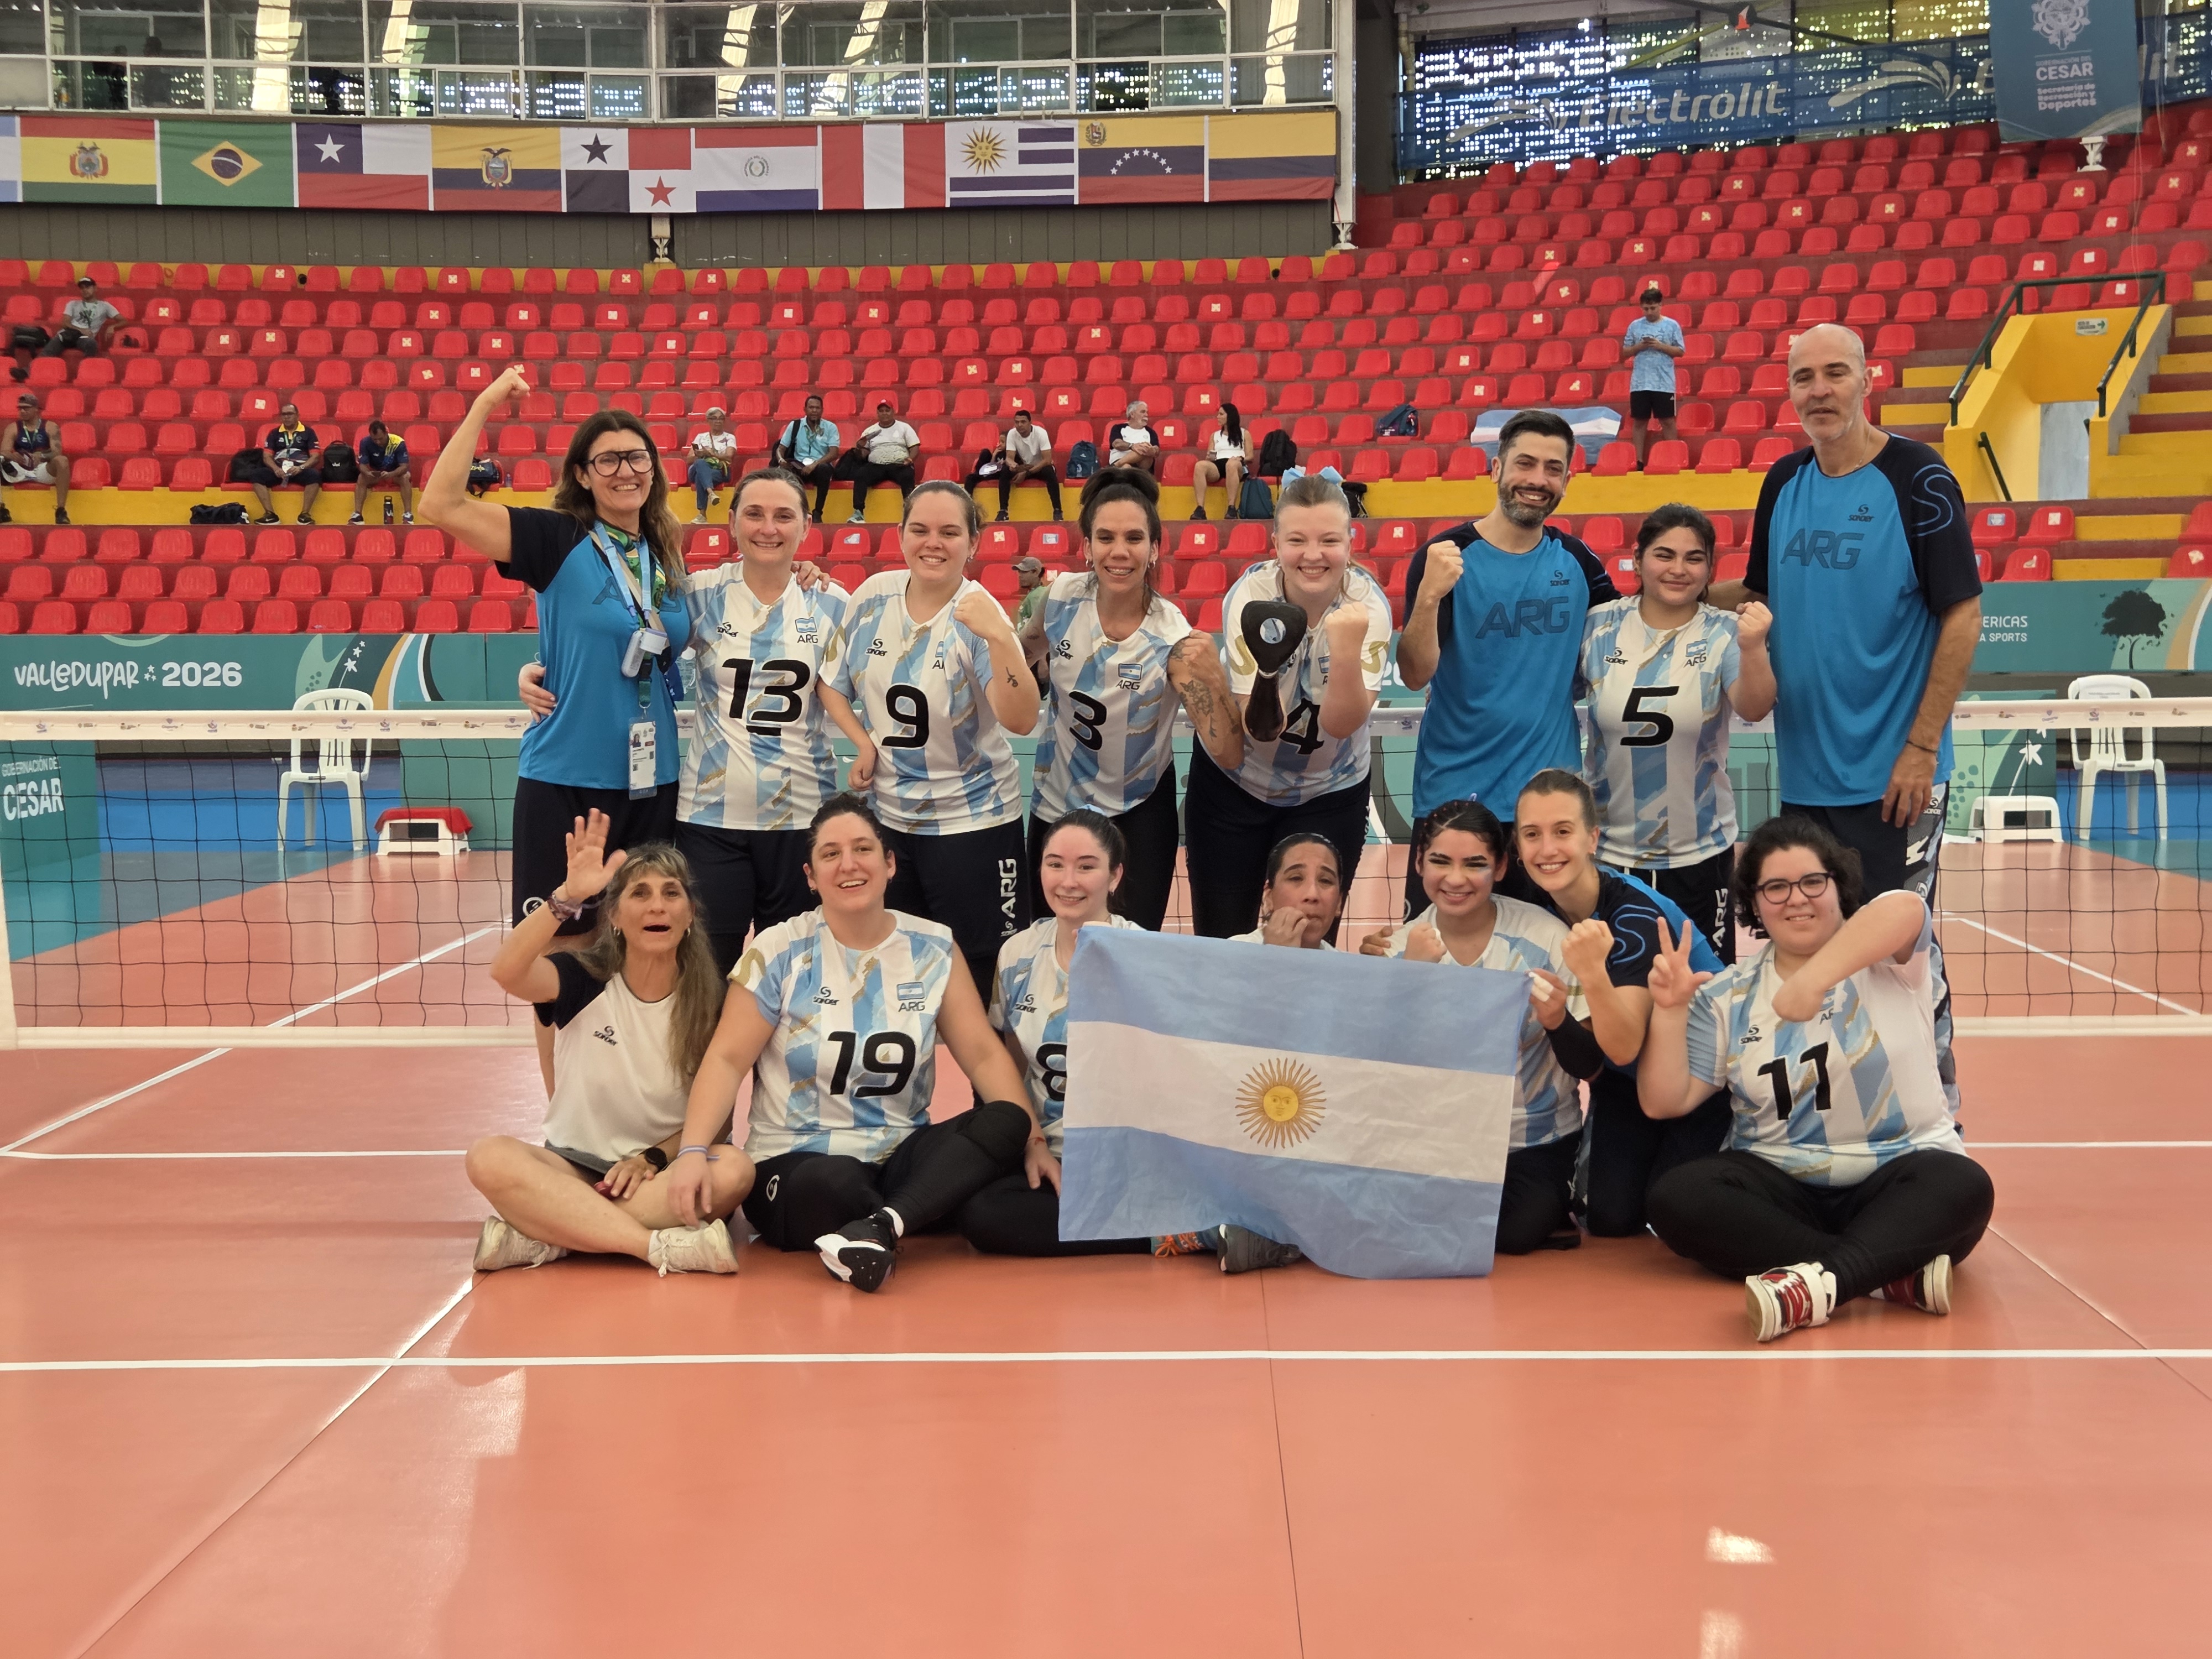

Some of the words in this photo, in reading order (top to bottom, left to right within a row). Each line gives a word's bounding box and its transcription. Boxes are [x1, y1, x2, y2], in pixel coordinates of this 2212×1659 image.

[2036, 62, 2094, 81] CESAR
[1578, 81, 1787, 130] Electrolit
[1780, 528, 1865, 570] ARG
[797, 634, 818, 643] ARG
[1475, 596, 1570, 639] ARG
[1983, 615, 2028, 628] ERICAS
[1989, 633, 2027, 642] SPORTS
[162, 662, 242, 687] 2026
[722, 659, 811, 722] 13
[1115, 680, 1140, 690] ARG
[881, 685, 929, 748] 9
[1068, 691, 1107, 750] 3
[1279, 698, 1324, 754] 4
[1620, 686, 1679, 745] 5
[3, 778, 64, 820] CESAR
[998, 858, 1017, 919] ARG
[1712, 888, 1728, 948] ARG
[898, 1001, 926, 1012] ARG
[828, 1031, 916, 1097] 19
[1036, 1044, 1067, 1101] 8
[1757, 1041, 1832, 1120] 11
